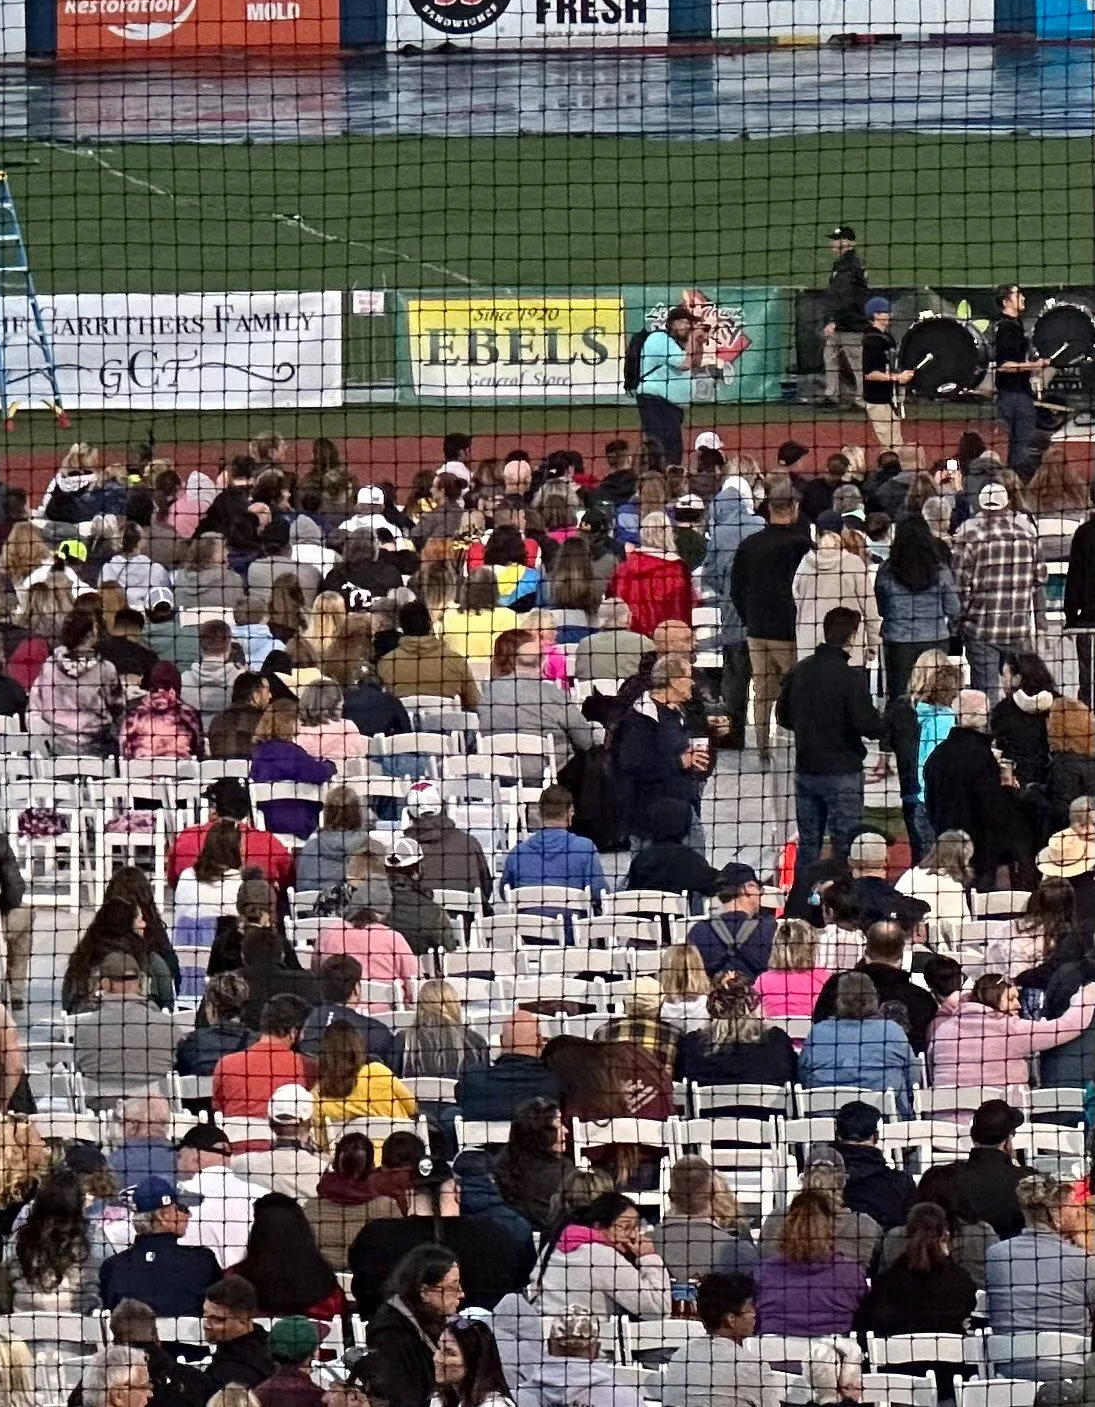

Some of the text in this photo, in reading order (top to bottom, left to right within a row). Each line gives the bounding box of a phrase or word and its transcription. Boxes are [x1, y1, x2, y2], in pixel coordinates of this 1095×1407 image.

[247, 3, 300, 21] MOLD
[421, 3, 499, 29] SANDWICHES
[474, 307, 560, 322] Since 1920
[423, 326, 610, 366] EBELS
[533, 372, 570, 386] Store
